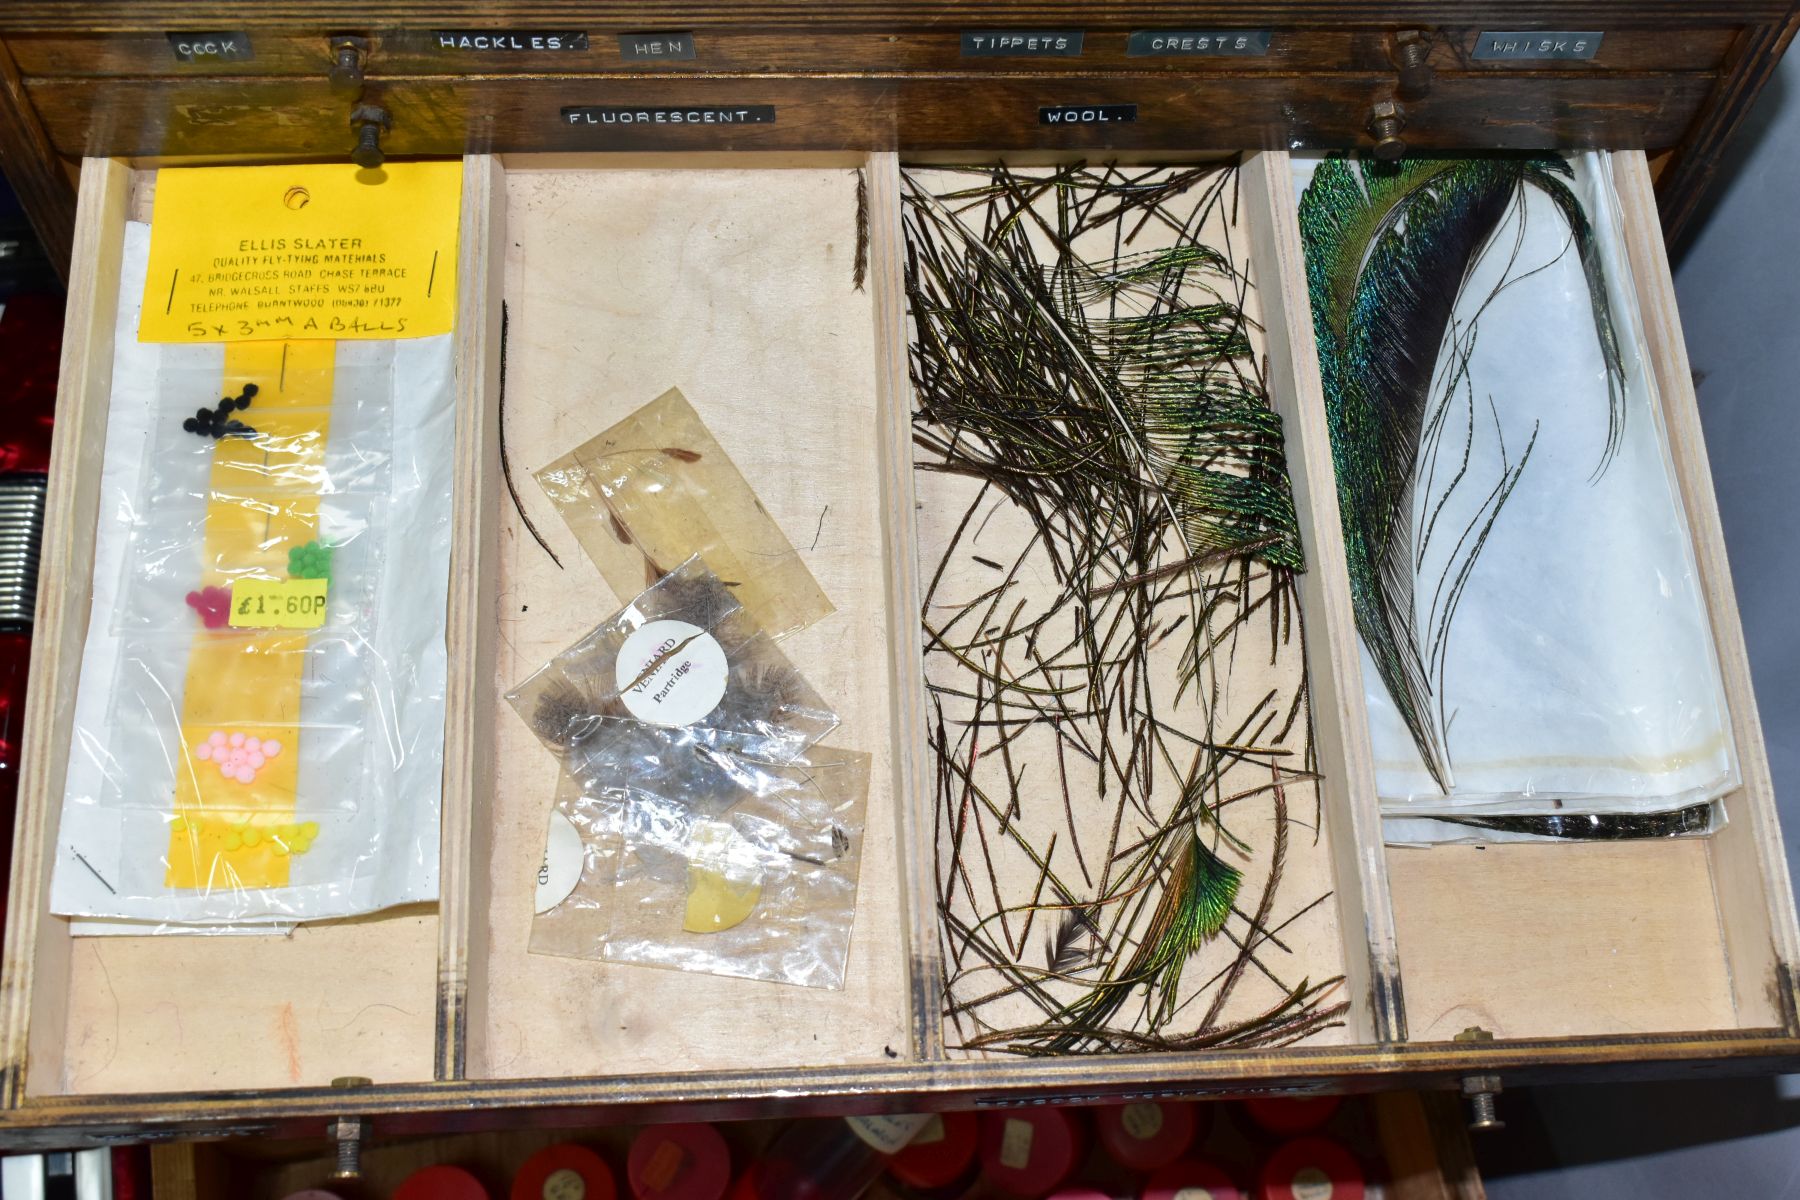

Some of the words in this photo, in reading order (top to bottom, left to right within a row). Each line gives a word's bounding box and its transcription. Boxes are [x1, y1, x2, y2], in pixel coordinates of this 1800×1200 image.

[440, 36, 574, 49] HACKLES.
[634, 42, 682, 55] HEN
[1151, 36, 1249, 51] CRESTS
[1492, 39, 1587, 53] WHISKS
[570, 110, 762, 125] FLUORESCENT.
[1047, 110, 1122, 123] WOOL.
[239, 239, 286, 252] ELLIS
[293, 238, 363, 250] SLATER
[213, 255, 259, 268] QUALITY
[263, 253, 319, 266] FLY-TYING
[324, 253, 387, 264] MATERIALS
[319, 268, 354, 279] CHASE
[360, 267, 407, 278] TERRACE
[190, 301, 249, 314] TELEPHONE
[329, 317, 407, 333] BALLS
[652, 660, 692, 705] Partridge
